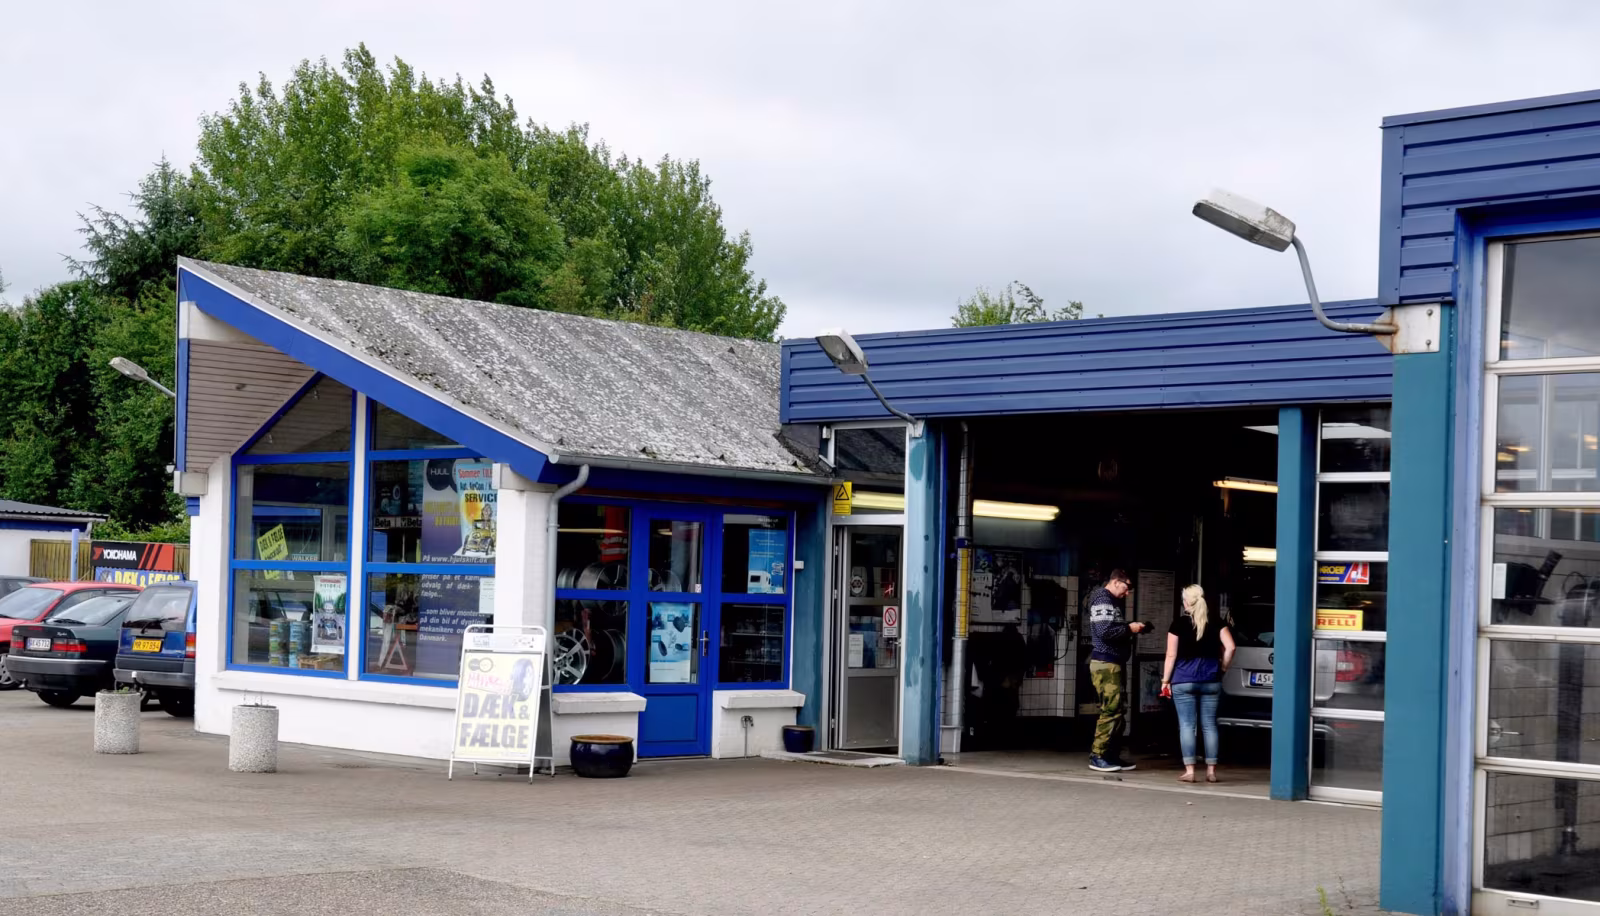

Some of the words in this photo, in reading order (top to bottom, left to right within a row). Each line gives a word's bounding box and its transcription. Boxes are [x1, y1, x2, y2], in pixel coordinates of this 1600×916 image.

[430, 468, 450, 476] HJUL
[103, 549, 137, 561] YOKOHAMA
[421, 582, 442, 590] udvalg
[439, 608, 456, 616] bliver
[420, 616, 428, 624] på
[429, 616, 440, 624] din
[451, 617, 459, 625] af
[420, 625, 454, 633] mekanikere
[419, 634, 448, 642] Danmark.
[1257, 673, 1268, 683] AS
[463, 692, 519, 719] DÆK
[518, 704, 530, 720] &
[459, 723, 529, 749] FÆLGE
